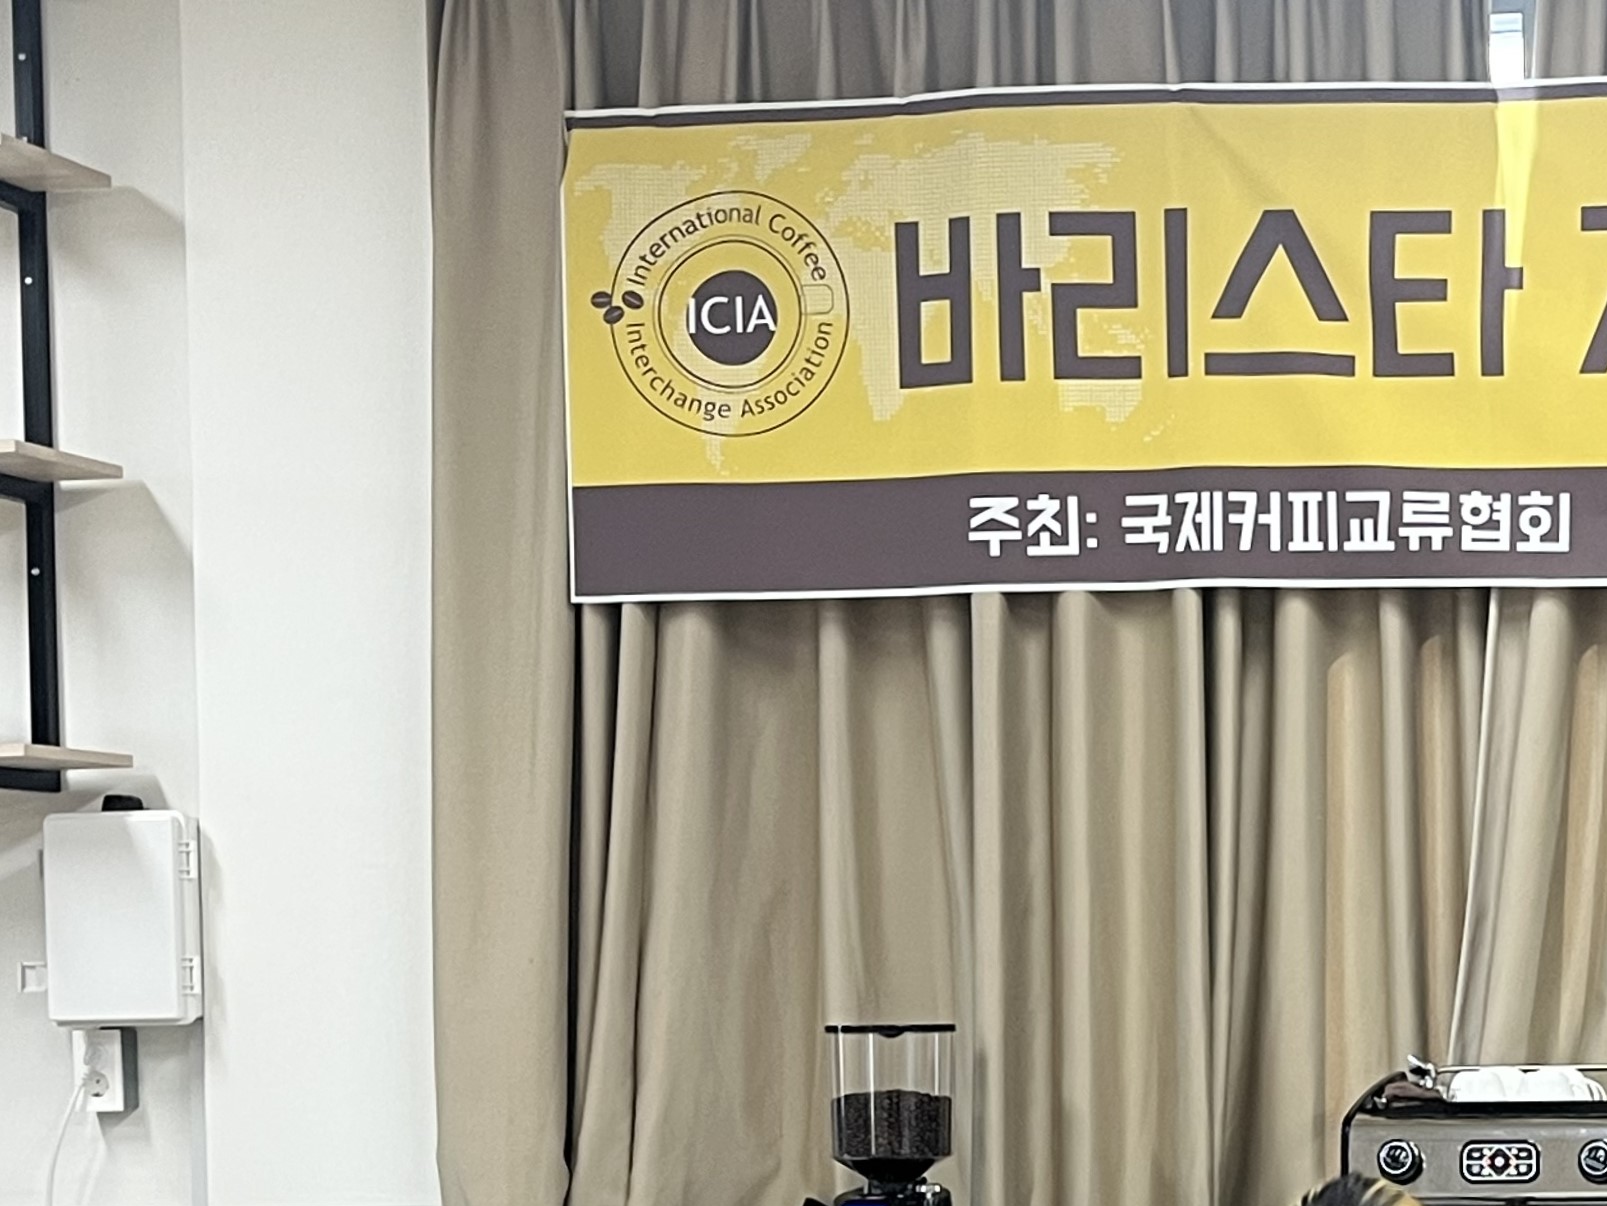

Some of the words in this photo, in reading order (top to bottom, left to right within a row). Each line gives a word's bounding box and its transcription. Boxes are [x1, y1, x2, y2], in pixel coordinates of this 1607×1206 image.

[625, 205, 762, 287] International
[768, 213, 827, 282] Coffee
[688, 294, 777, 335] ICIA
[894, 207, 1523, 388] 바리스타
[625, 322, 732, 421] Interchange
[740, 321, 834, 418] Association
[967, 494, 1098, 557] 주최:
[1120, 490, 1571, 554] 국제커피교류협회
